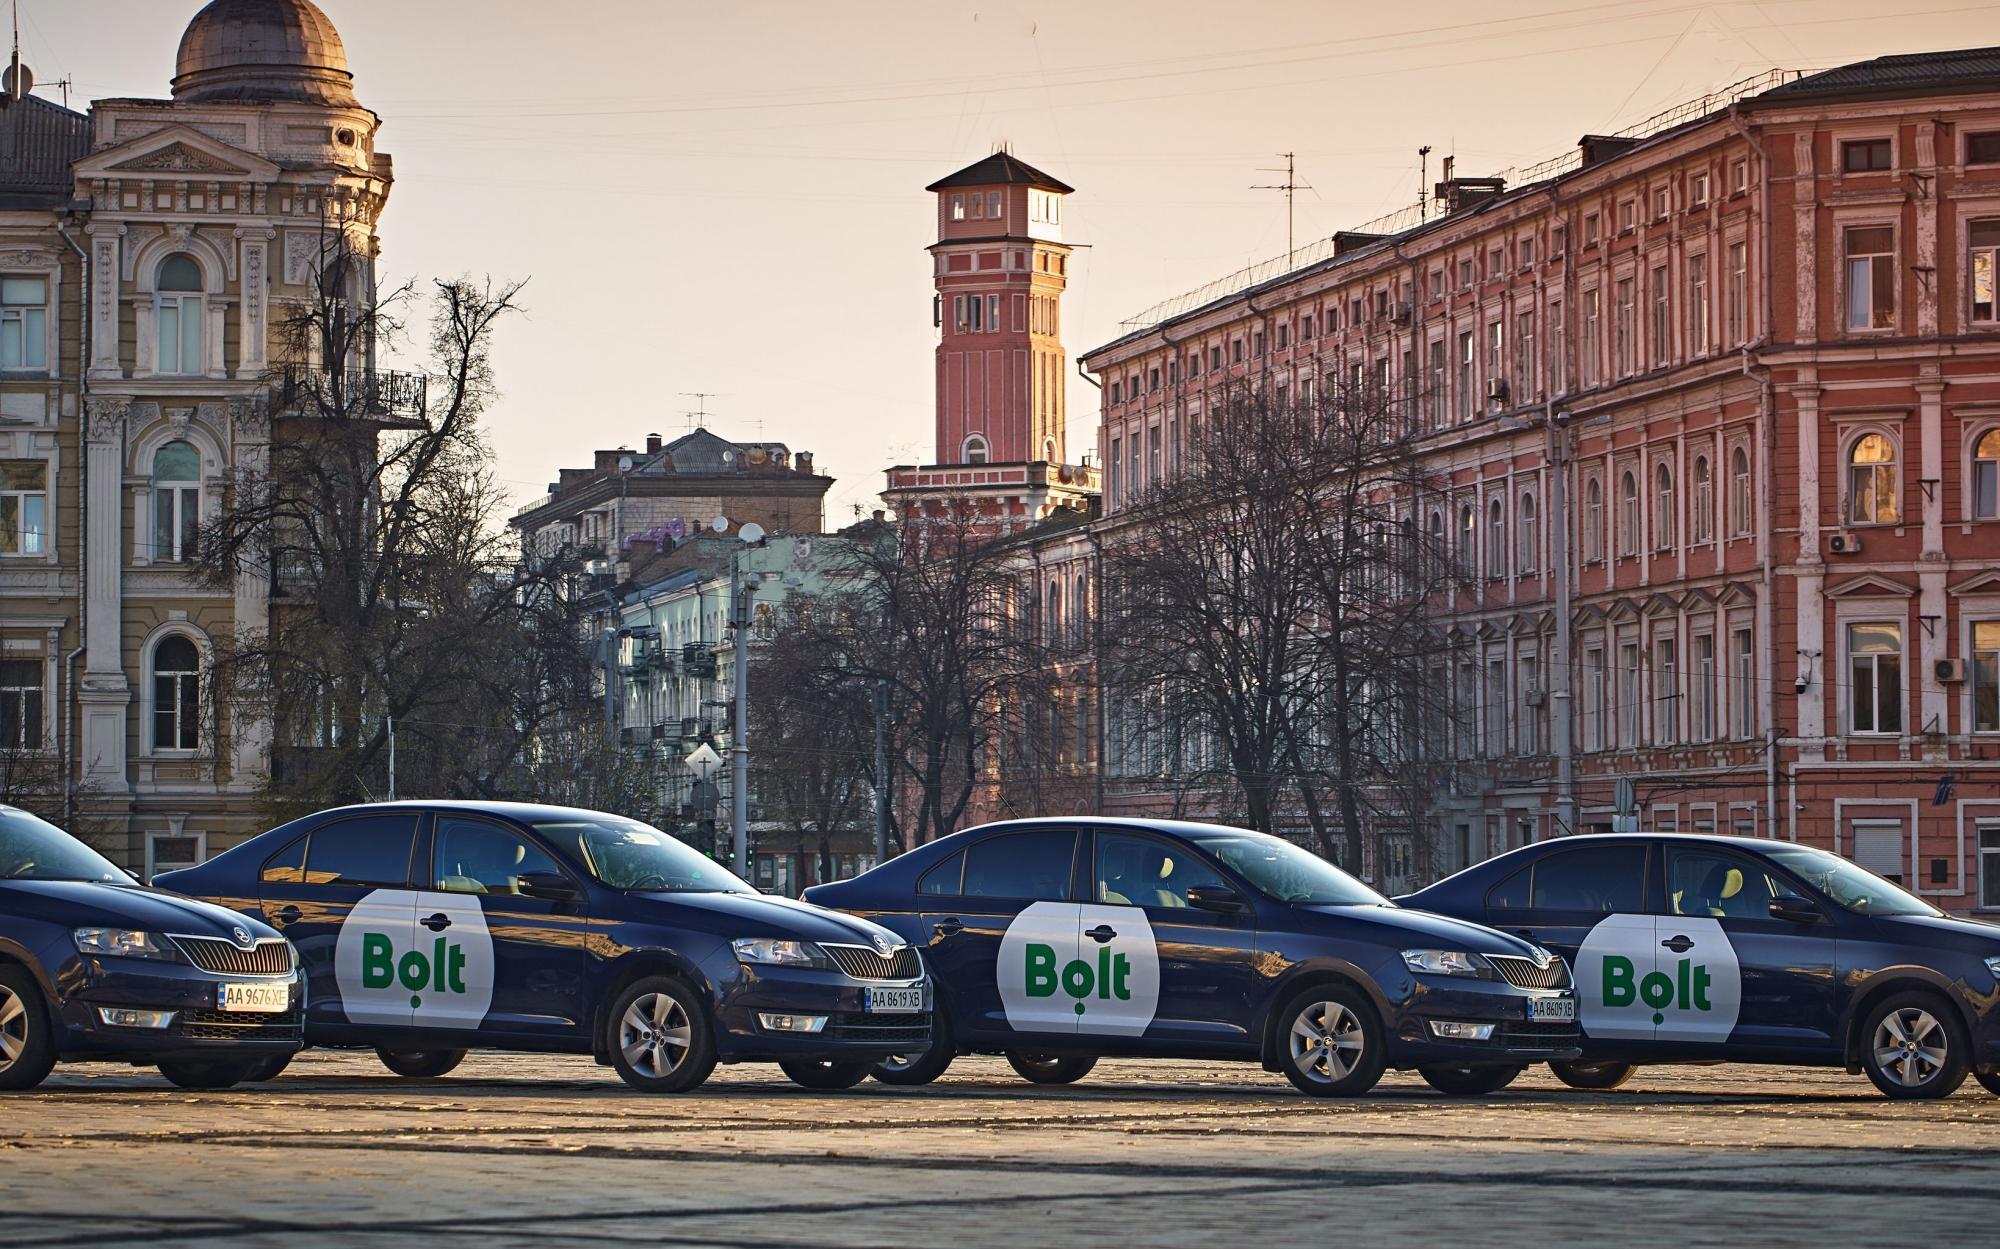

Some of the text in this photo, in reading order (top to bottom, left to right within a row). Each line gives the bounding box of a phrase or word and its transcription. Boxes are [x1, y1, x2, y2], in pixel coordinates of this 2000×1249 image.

[363, 933, 466, 1008] Bolt
[1025, 943, 1131, 1015] Bolt
[1603, 956, 1712, 1025] Bolt
[226, 988, 287, 1005] AA 9676 XE
[872, 992, 920, 1007] AA 8619 XB
[1534, 1001, 1573, 1017] AA 8609 XB
